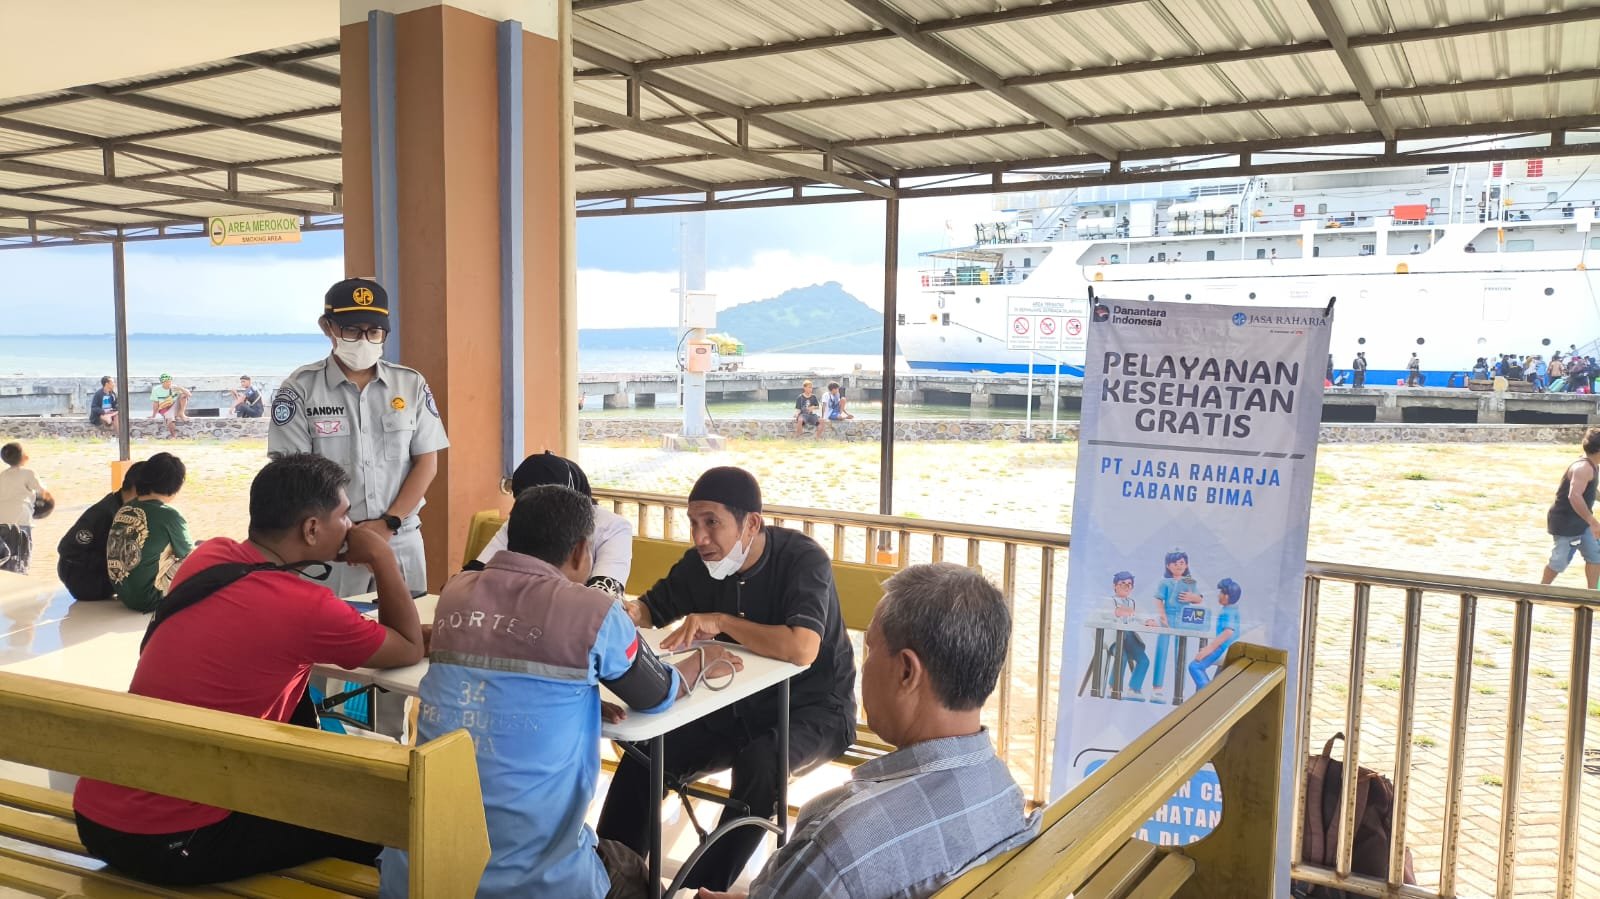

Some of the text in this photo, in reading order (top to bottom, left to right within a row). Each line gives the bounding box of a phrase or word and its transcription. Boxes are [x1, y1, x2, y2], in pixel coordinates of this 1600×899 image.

[228, 218, 297, 233] AREA MEROKOK
[1112, 315, 1162, 327] Indonesia
[1113, 305, 1167, 318] Danantara
[1250, 315, 1327, 327] JASA RAHARJA
[1102, 351, 1299, 386] PELAYANAN
[1101, 378, 1295, 414] KESEHATAN
[306, 406, 345, 417] SANDHY
[1135, 408, 1251, 439] GRATIS
[1101, 456, 1281, 487] PT JASA RAHARJA
[1122, 480, 1253, 507] CABANG BIMA
[437, 611, 543, 647] PORTER
[457, 680, 487, 706] 34
[1148, 804, 1221, 829] HATAN
